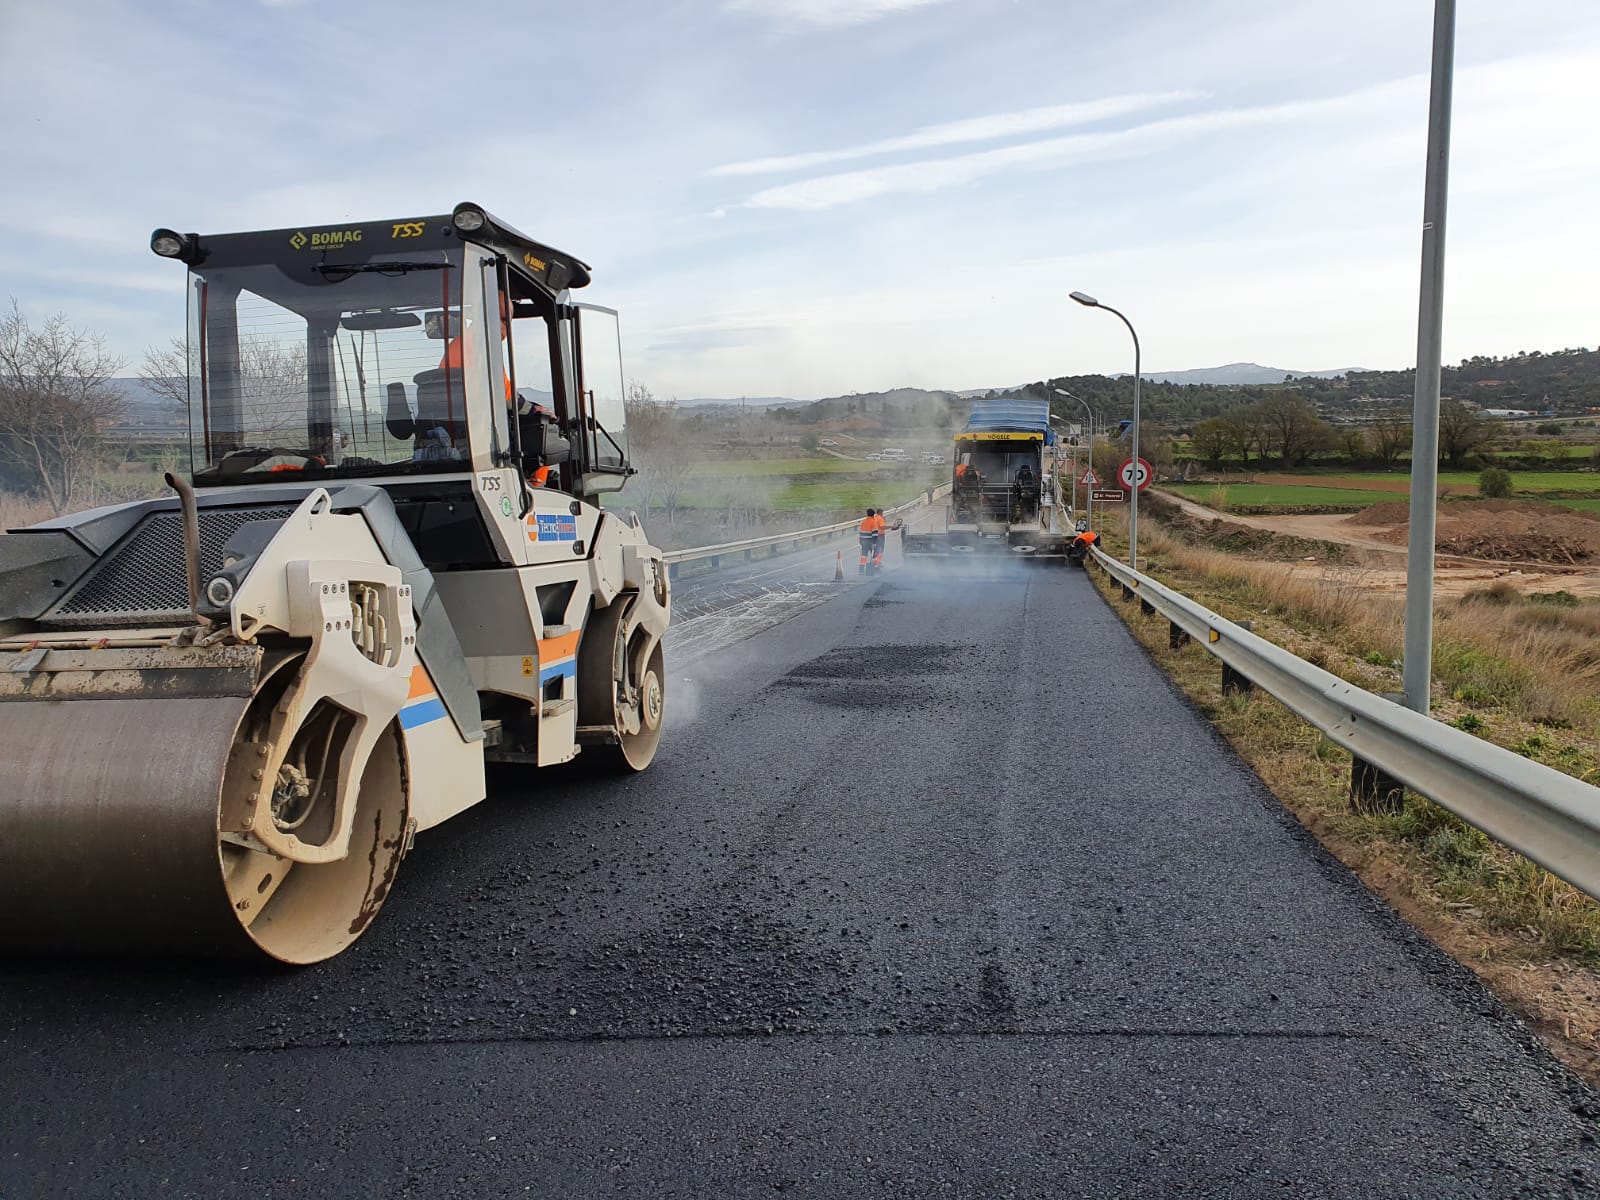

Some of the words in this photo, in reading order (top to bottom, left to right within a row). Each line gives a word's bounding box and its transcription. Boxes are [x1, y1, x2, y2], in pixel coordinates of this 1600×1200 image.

[391, 221, 425, 238] TSS
[311, 230, 362, 245] BOMAG
[1125, 469, 1144, 481] 70
[481, 476, 501, 491] TSS
